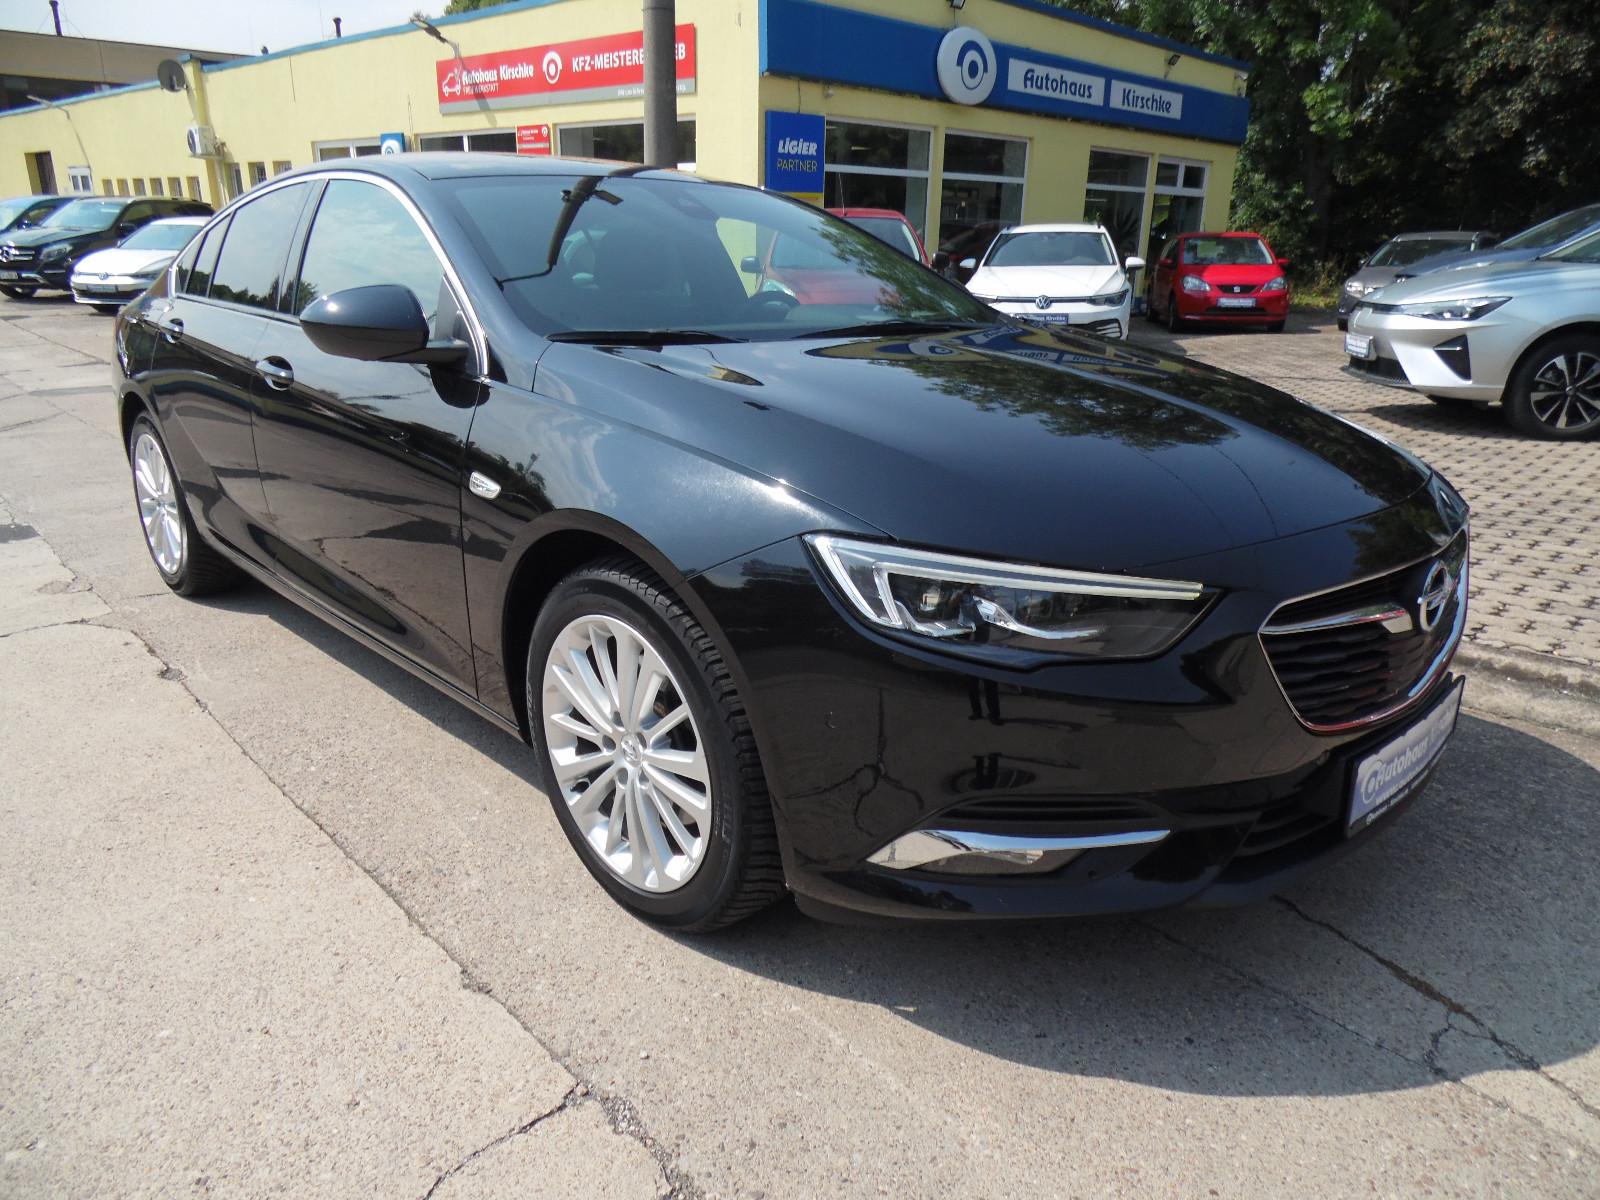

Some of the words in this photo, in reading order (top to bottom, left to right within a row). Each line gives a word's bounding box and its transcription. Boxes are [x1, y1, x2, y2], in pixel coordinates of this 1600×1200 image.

[462, 68, 498, 85] Autohaus
[500, 62, 534, 81] Kirschke
[1023, 68, 1093, 99] Autohaus
[1122, 87, 1172, 114] Kirschke
[777, 158, 818, 173] PARTNER
